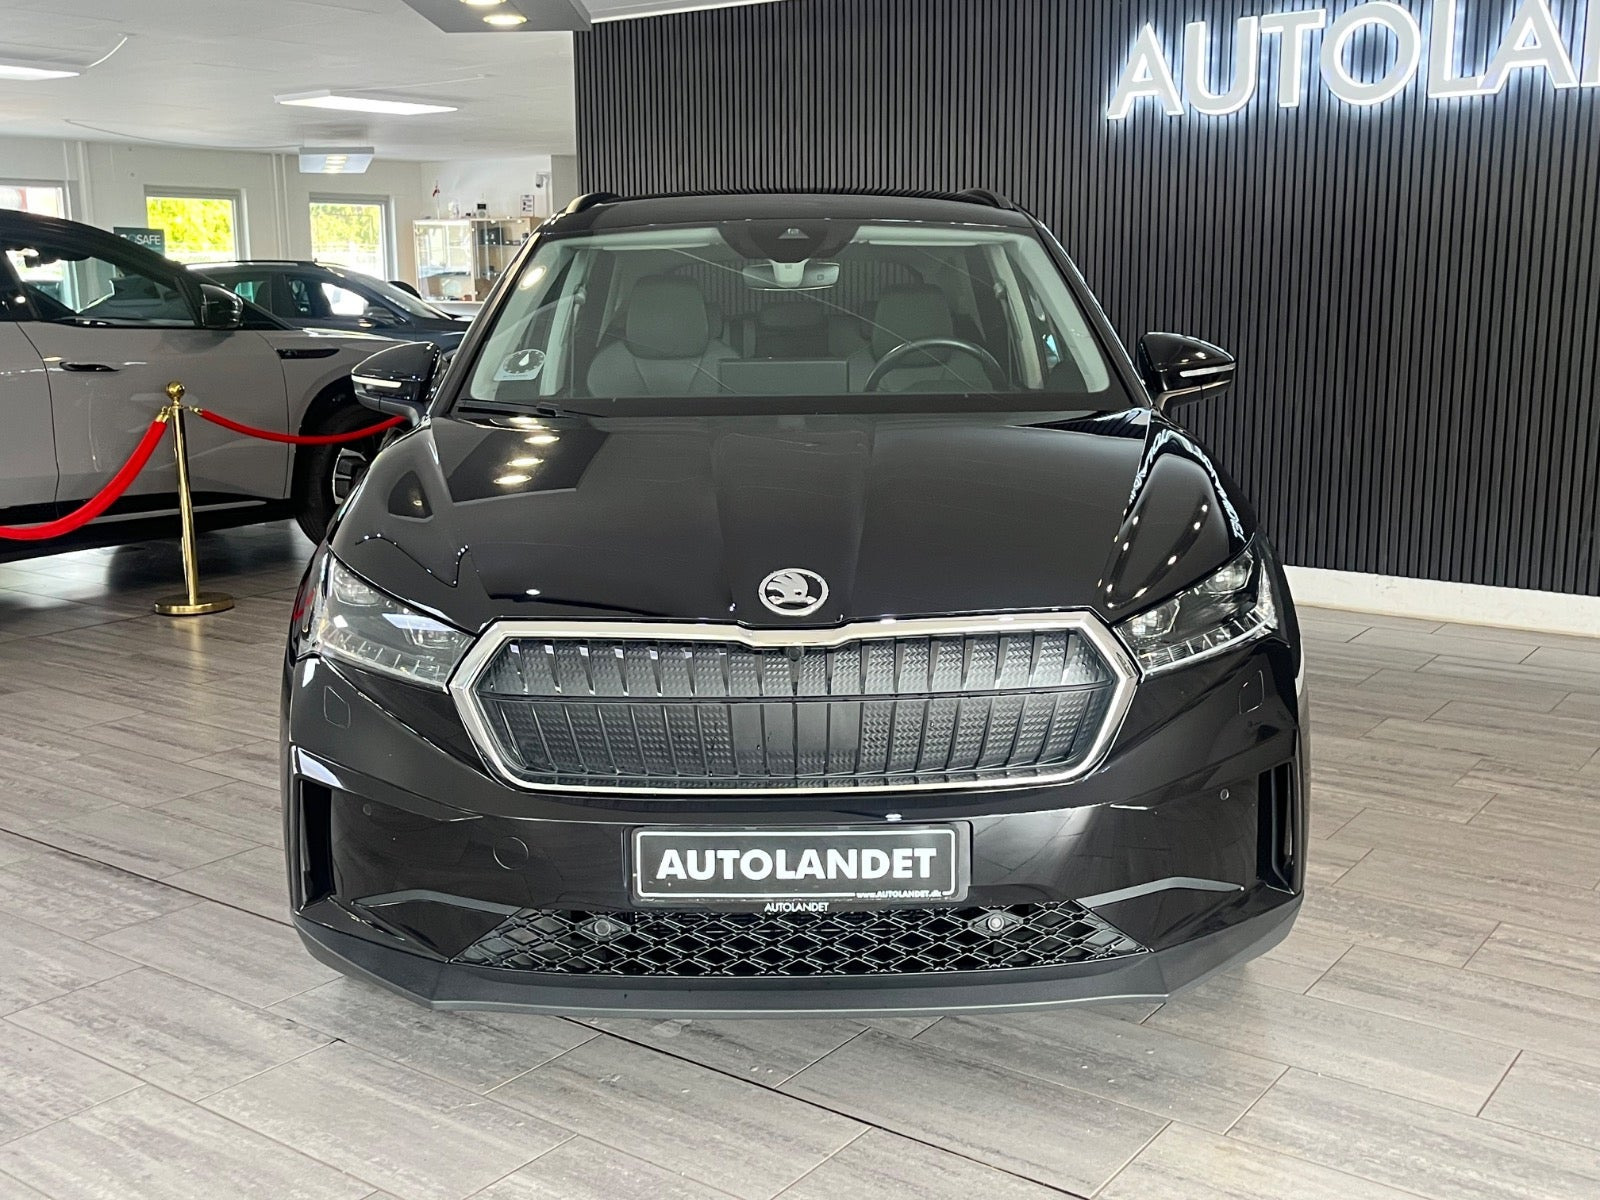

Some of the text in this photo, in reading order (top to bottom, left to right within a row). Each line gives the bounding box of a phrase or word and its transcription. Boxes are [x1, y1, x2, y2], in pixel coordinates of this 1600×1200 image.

[1106, 0, 1600, 120] AUTOLA
[656, 848, 937, 881] AUTOLANDET
[764, 902, 829, 912] AUTOLANDET
